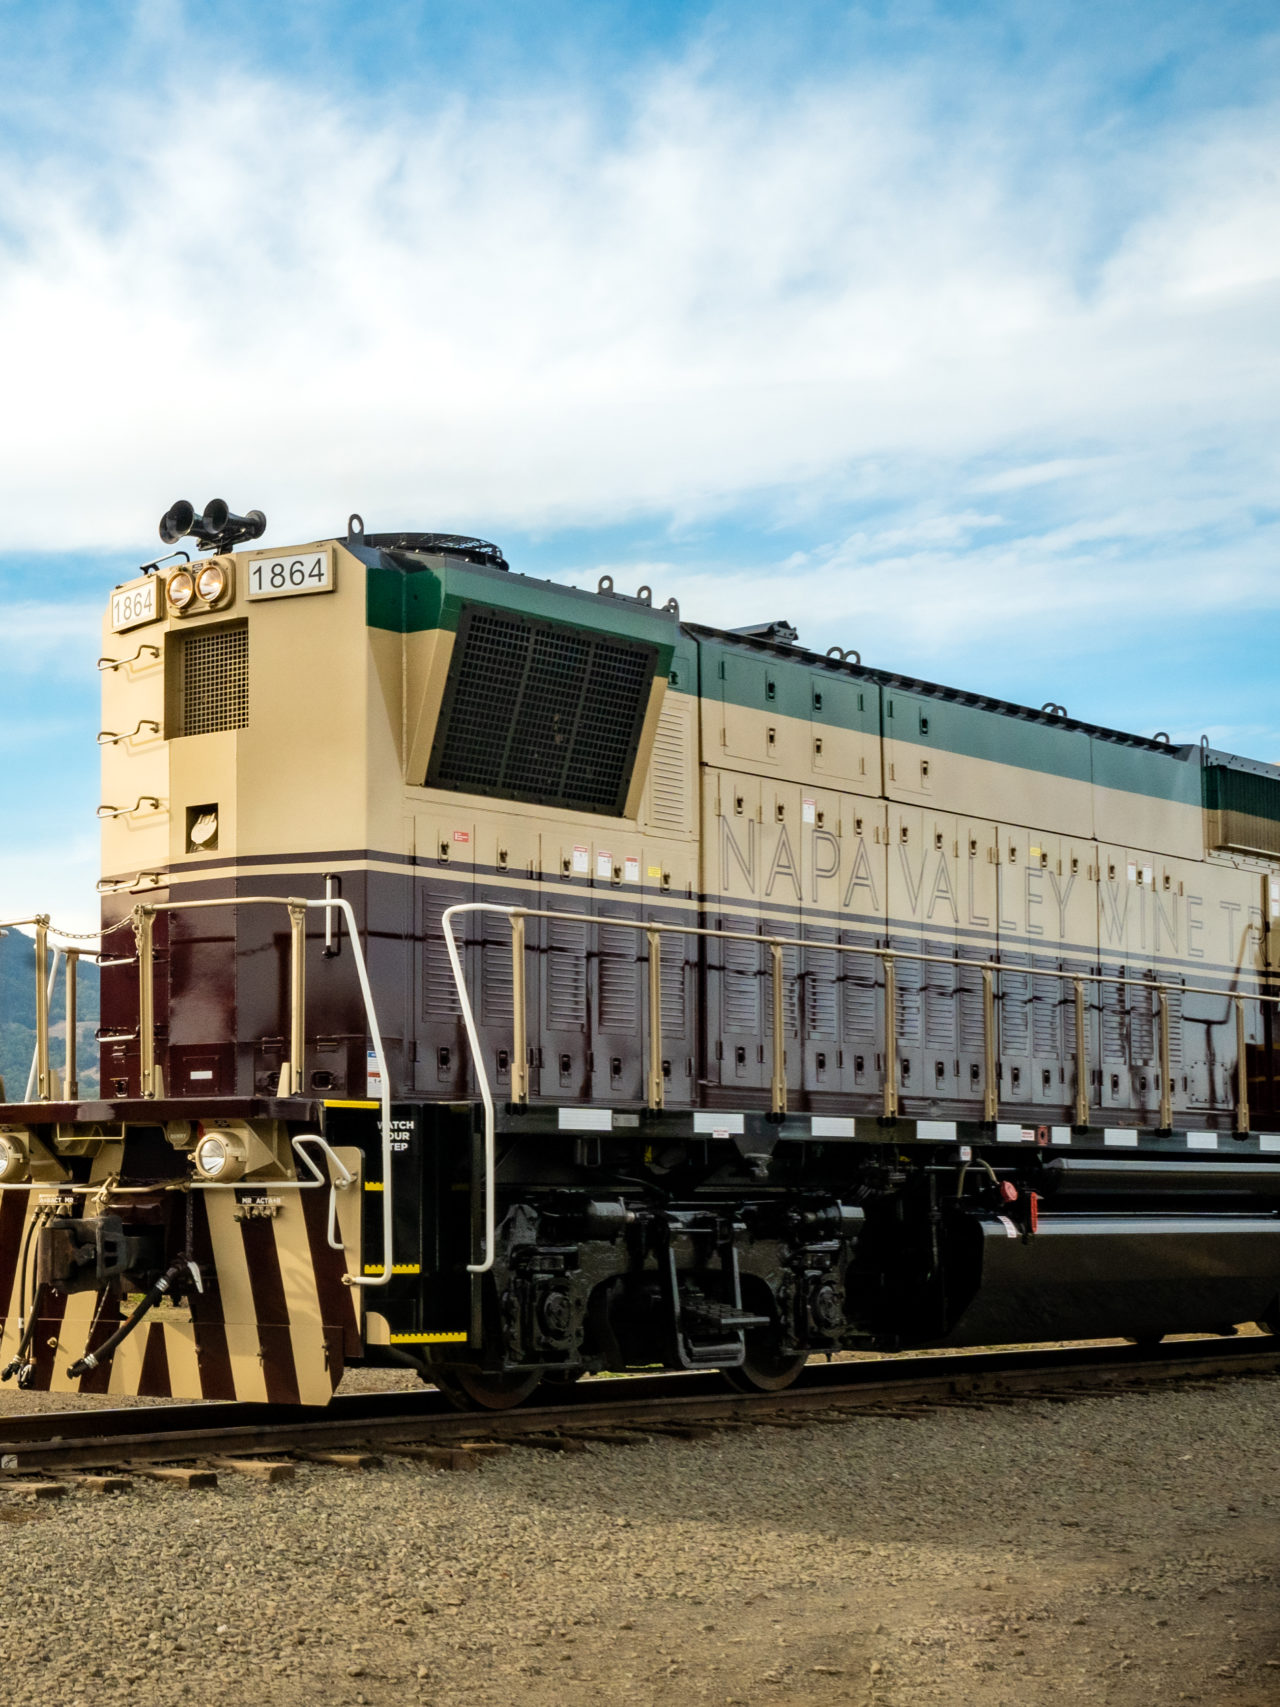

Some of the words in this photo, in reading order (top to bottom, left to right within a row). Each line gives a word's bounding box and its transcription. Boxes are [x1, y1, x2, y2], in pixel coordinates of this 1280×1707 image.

[253, 557, 325, 591] 1864
[114, 588, 153, 624] 1864
[721, 814, 879, 912] NAPA
[898, 842, 1077, 939] VALLEY
[1098, 879, 1205, 958] WINE
[381, 1131, 410, 1140] OUR
[388, 1142, 408, 1151] TEP
